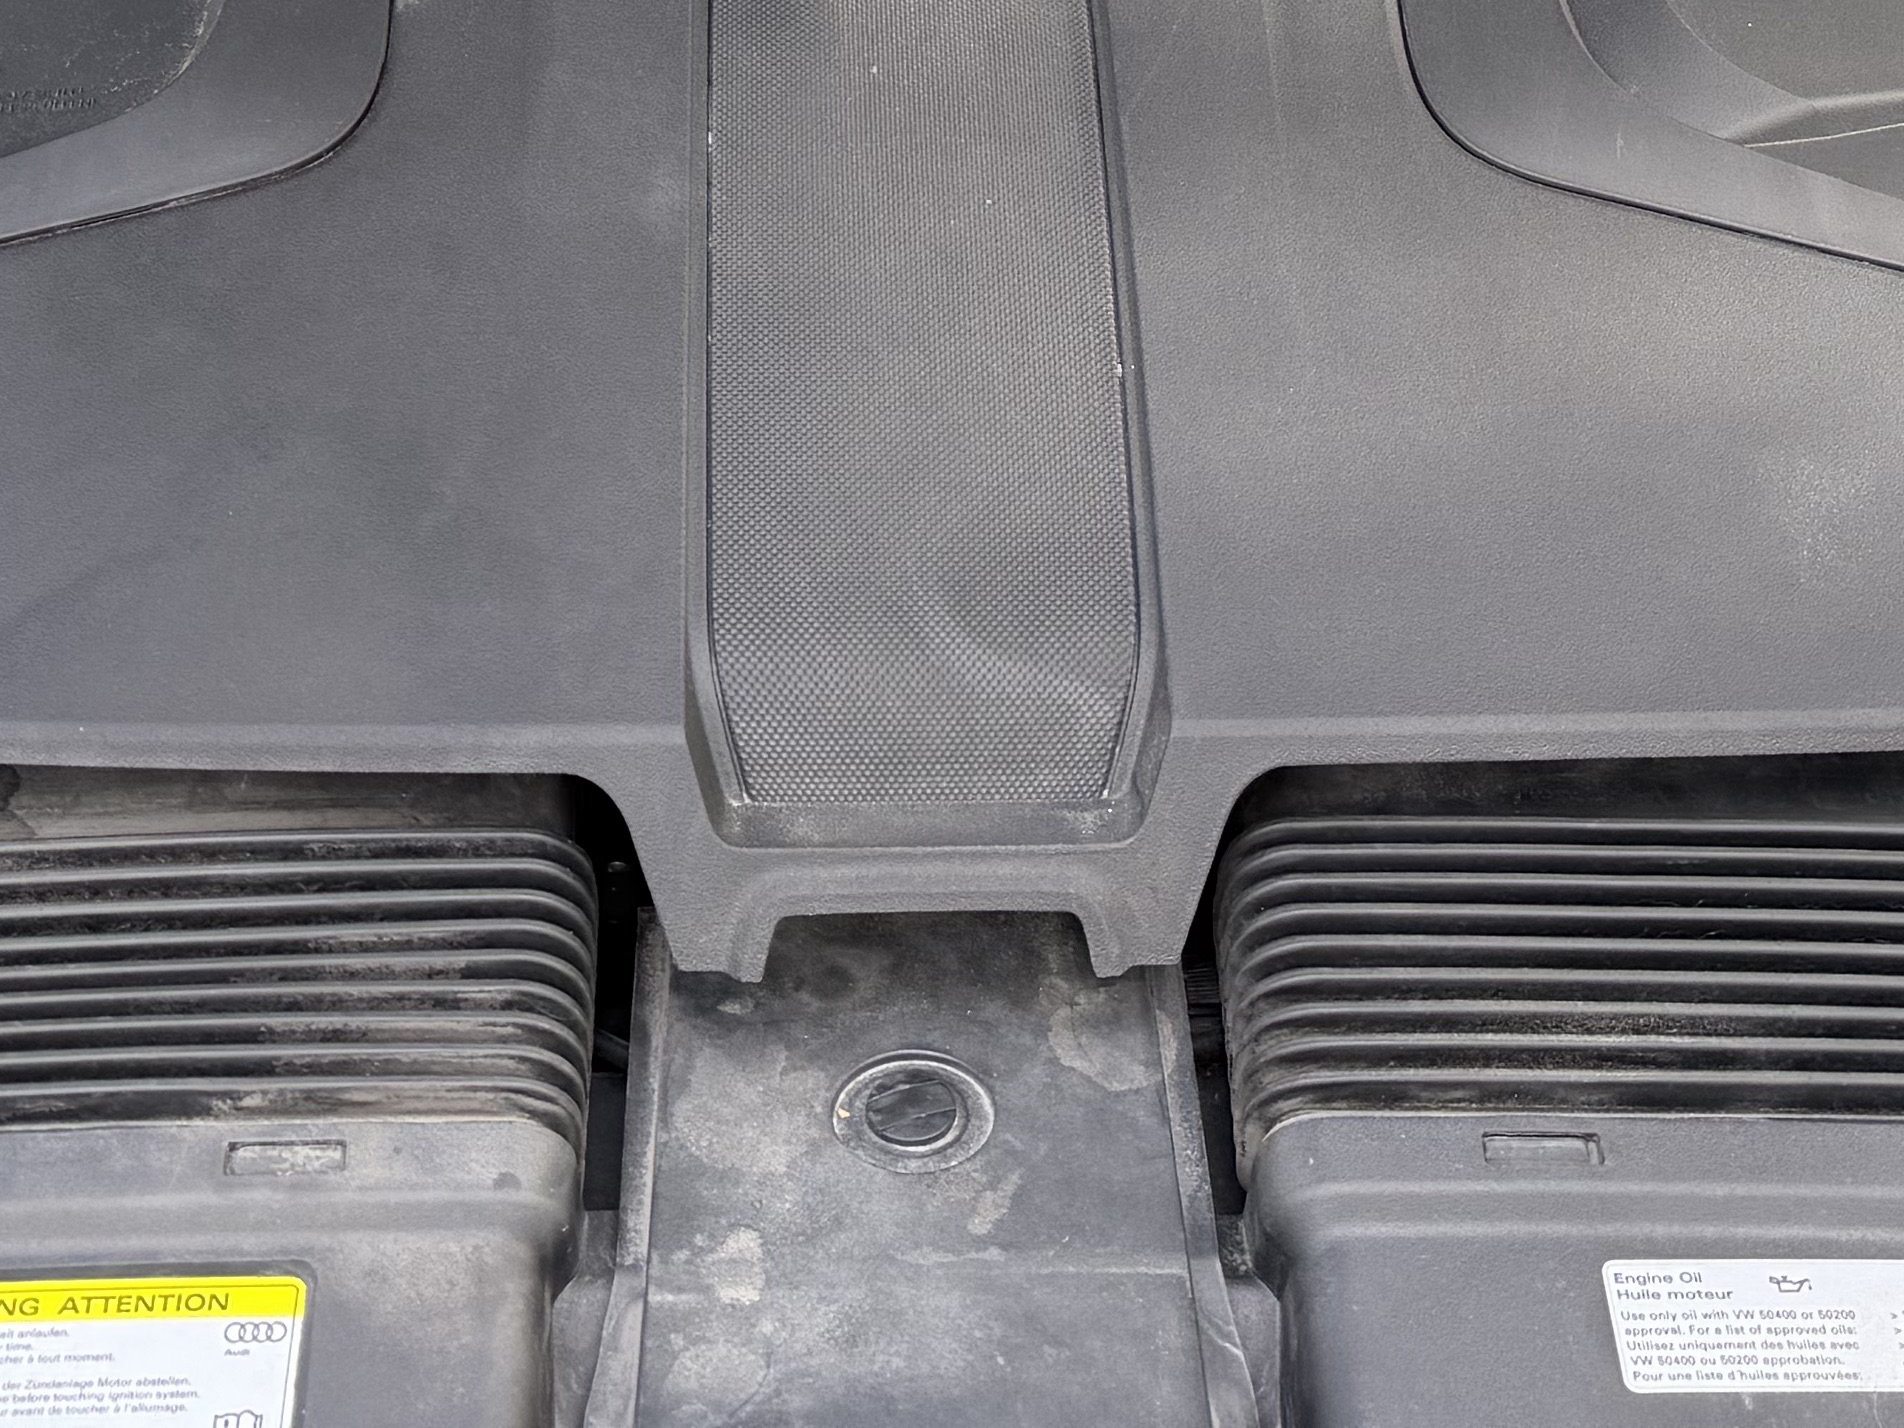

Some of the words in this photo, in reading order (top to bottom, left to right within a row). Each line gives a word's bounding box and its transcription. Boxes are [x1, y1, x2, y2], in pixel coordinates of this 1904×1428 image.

[1614, 1272, 1673, 1286] Engine
[1679, 1271, 1702, 1284] Oil
[1616, 1289, 1662, 1300] Huile
[1667, 1290, 1734, 1300] moteur
[58, 1293, 231, 1315] ATTENTION
[1620, 1310, 1646, 1321] Use
[1649, 1310, 1677, 1322] only
[1681, 1309, 1697, 1320] oil
[1701, 1309, 1729, 1320] with
[1732, 1309, 1755, 1320] VW
[1759, 1309, 1797, 1320] 50400
[1801, 1311, 1813, 1320] or
[1817, 1309, 1856, 1320] 50200
[1625, 1325, 1686, 1337] approval.
[1688, 1324, 1710, 1335] For
[1725, 1324, 1745, 1335] list
[1749, 1324, 1761, 1335] of
[1766, 1324, 1827, 1337] approved
[1831, 1324, 1857, 1335] oils:
[1626, 1340, 1675, 1351] Utilisez
[1679, 1339, 1756, 1352] uniquement
[1761, 1339, 1784, 1350] des
[1786, 1339, 1826, 1350] huiles
[1830, 1341, 1860, 1350] avec
[1630, 1355, 1653, 1366] VW
[1657, 1355, 1696, 1366] 50400
[1700, 1357, 1717, 1366] ou
[1719, 1355, 1759, 1366] 50200
[1762, 1354, 1846, 1368] approbation.
[97, 1377, 133, 1387] Motor
[1633, 1371, 1663, 1382] Pour
[1667, 1372, 1692, 1381] une
[1696, 1370, 1723, 1381] liste
[1727, 1370, 1779, 1381] d'huiles
[13, 1393, 50, 1404] before
[53, 1391, 104, 1403] touching
[108, 1390, 153, 1403] ignition
